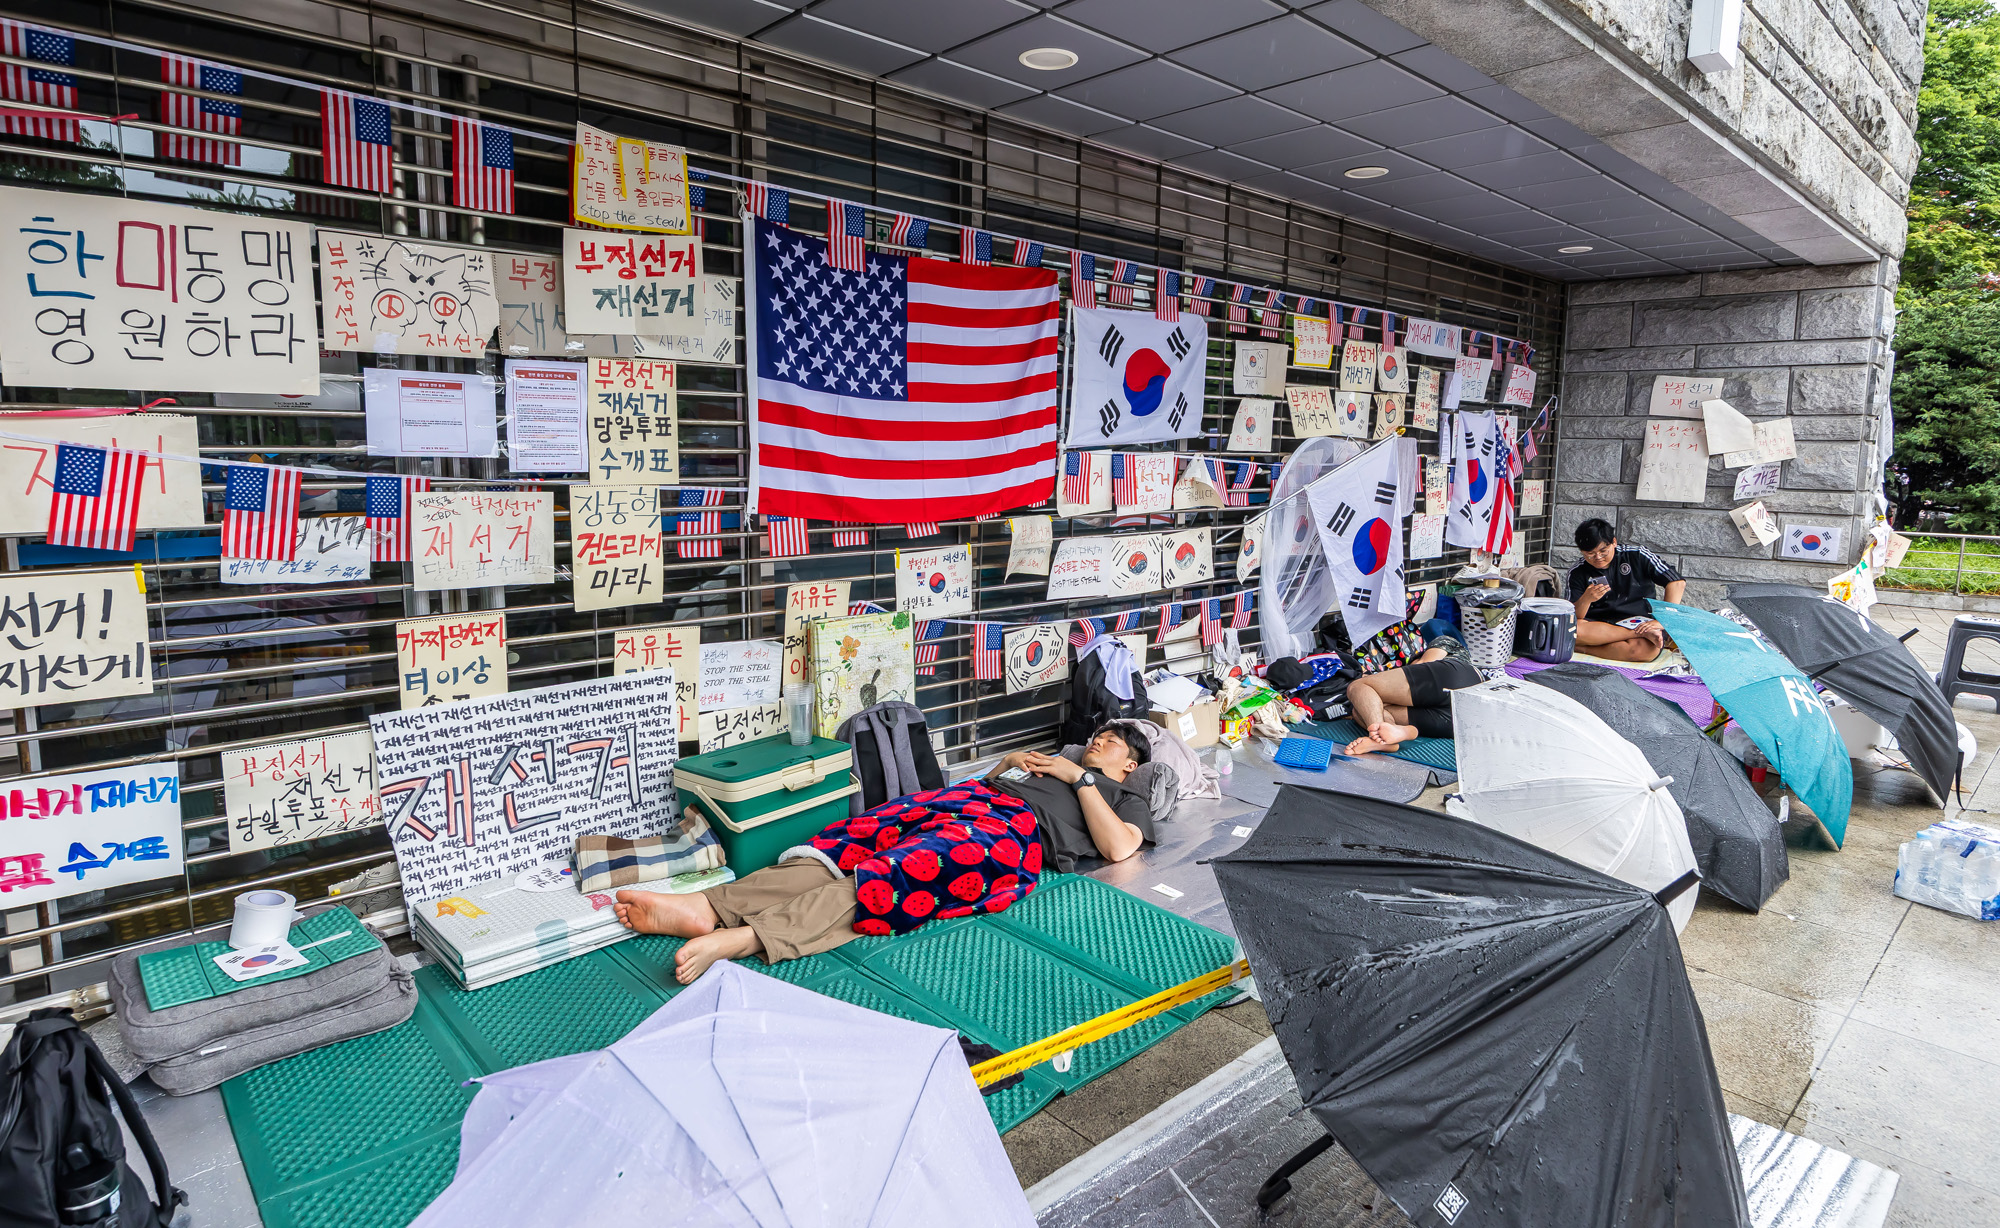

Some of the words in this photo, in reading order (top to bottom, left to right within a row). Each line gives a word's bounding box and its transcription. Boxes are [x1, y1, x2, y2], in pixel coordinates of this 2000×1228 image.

[613, 210, 636, 225] the
[19, 215, 295, 305] 한미동맹
[575, 238, 696, 280] 부정선거
[327, 240, 360, 347] 부정선거
[592, 282, 695, 318] 재선거
[34, 307, 305, 365] 영원하라
[1406, 323, 1431, 344] MAGA
[1345, 343, 1375, 363] 부정선거
[595, 360, 674, 389] 부정선거
[1345, 366, 1373, 385] 재선거
[598, 392, 668, 417] 재선거
[1290, 390, 1329, 412] 부정선거
[1670, 398, 1703, 410] 재선
[594, 416, 672, 443] 당일투표
[1295, 410, 1332, 431] 재선거
[599, 447, 673, 480] 수개표
[1136, 457, 1166, 471] 정선거
[1136, 469, 1170, 493] 선거
[1737, 468, 1779, 492] 수개표
[574, 487, 661, 529] 장동혁
[1137, 493, 1167, 510] 정선거
[421, 515, 533, 569] 재선거
[577, 532, 662, 566] 건드리지
[942, 550, 967, 563] 재선거
[590, 563, 652, 597] 마라
[942, 586, 970, 602] 수개표
[1081, 576, 1101, 585] STEAL
[791, 584, 838, 611] 자유는
[616, 632, 683, 666] 자유는
[785, 635, 808, 655] 주어
[703, 678, 725, 687] STOP
[728, 676, 744, 685] THE
[746, 675, 771, 684] STEAL
[704, 667, 726, 676] STOP
[728, 665, 744, 674] THE
[746, 663, 772, 672] STEAL
[389, 711, 440, 731] 재선거
[441, 703, 487, 721] 재선거
[487, 697, 532, 713] 재선거
[532, 690, 571, 705] 재선거
[571, 683, 608, 697] 재선거
[608, 680, 642, 692] 재선거
[642, 675, 672, 687] 재선거
[1325, 703, 1348, 719] NIKE
[380, 732, 431, 751] 재선거
[430, 724, 474, 739] 재선거
[474, 715, 517, 731] 재선거
[518, 710, 554, 725] 재선거
[555, 703, 590, 718] 재선거
[591, 699, 623, 713] 재선거
[623, 694, 654, 706] 재선거
[406, 744, 447, 760] 재선거
[448, 735, 489, 751] 재선거
[488, 729, 523, 745] 재선거
[523, 725, 559, 738] 재선거
[559, 717, 596, 732] 재선거
[598, 711, 635, 725] 재선거
[635, 705, 672, 719] 재선거
[714, 700, 782, 749] 부정선거
[385, 760, 431, 777] 재선거
[639, 718, 671, 729] 재선거
[230, 741, 327, 787] 부정선거
[279, 752, 373, 801] 재선거
[84, 776, 179, 814] 재선거
[379, 725, 641, 847] 재선거
[236, 796, 329, 842] 당일투표
[58, 836, 170, 881] 수개표
[400, 843, 435, 858] 재선거
[426, 849, 467, 866] 재선거
[473, 838, 509, 855] 재선거
[405, 865, 448, 883] 재선거
[452, 855, 494, 873] 재선거
[430, 877, 463, 892] 재선거
[469, 868, 501, 883] 재선거
